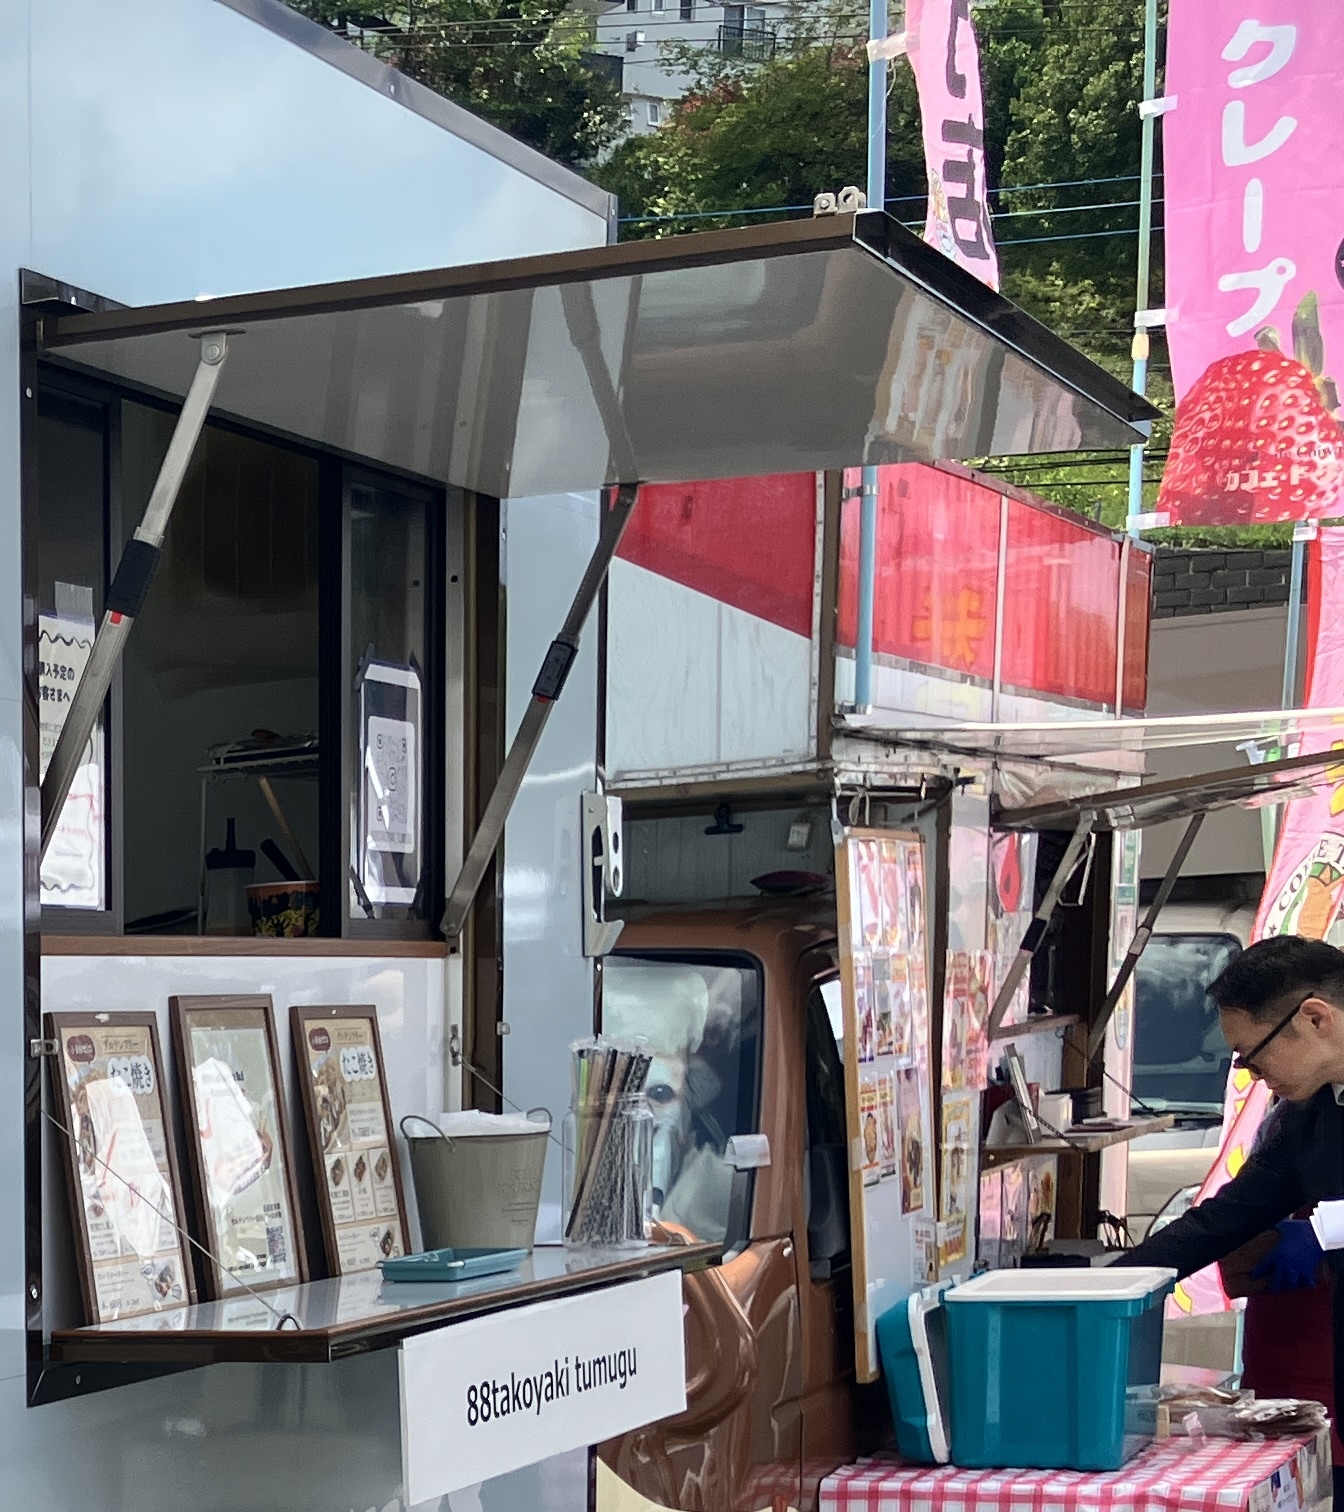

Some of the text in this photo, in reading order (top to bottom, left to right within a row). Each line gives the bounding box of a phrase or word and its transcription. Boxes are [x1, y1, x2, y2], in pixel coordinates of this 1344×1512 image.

[1217, 18, 1298, 338] クレープ
[466, 1346, 638, 1427] 88takoyaki tumugu
